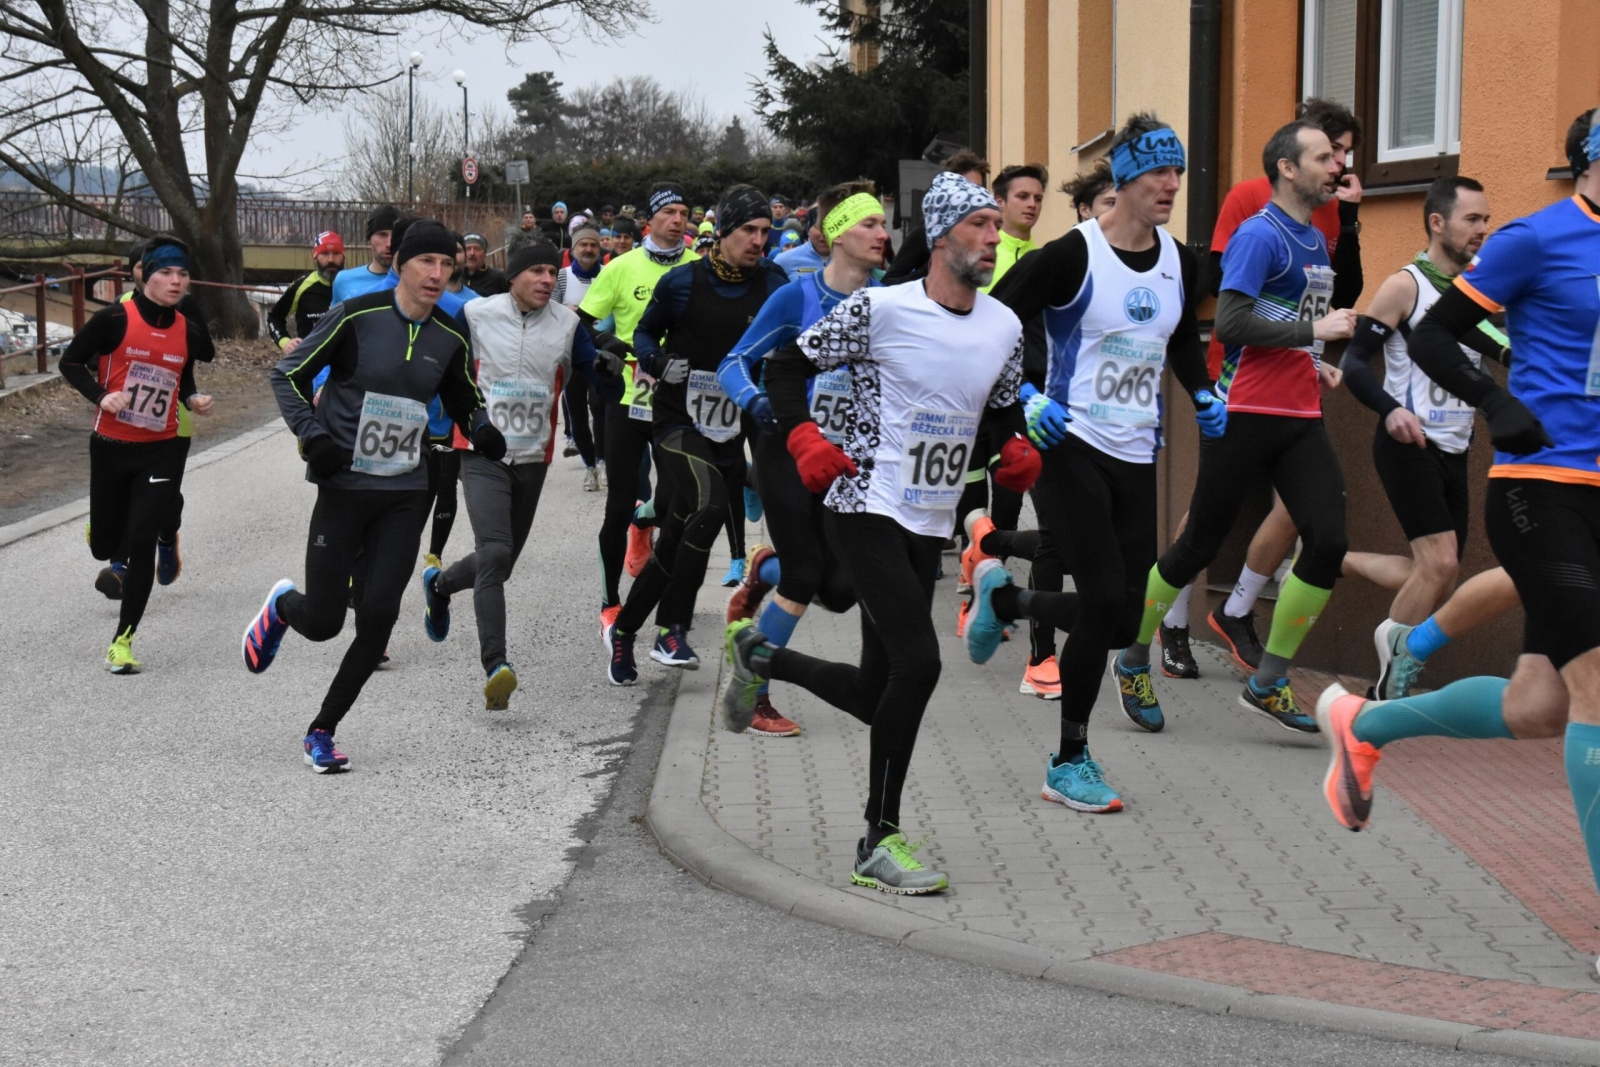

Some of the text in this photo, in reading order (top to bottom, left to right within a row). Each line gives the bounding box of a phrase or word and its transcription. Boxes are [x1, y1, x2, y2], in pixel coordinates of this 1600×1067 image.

[1101, 344, 1163, 361] BĚŽECKÁ LIGA
[690, 373, 714, 382] ZIMNÍ
[1095, 360, 1156, 408] 666
[127, 383, 169, 418] 175
[364, 406, 402, 419] BĚŽECKÁ
[406, 412, 425, 421] LIGA
[366, 397, 393, 408] ZIMNÍ
[691, 394, 738, 428] 170
[813, 393, 848, 432] 55
[492, 401, 544, 434] 665
[911, 422, 954, 436] BĚŽECKÁ
[915, 412, 946, 424] ZIMNÍ
[360, 420, 420, 461] 654
[908, 441, 968, 487] 169
[1506, 487, 1538, 533] kilpi
